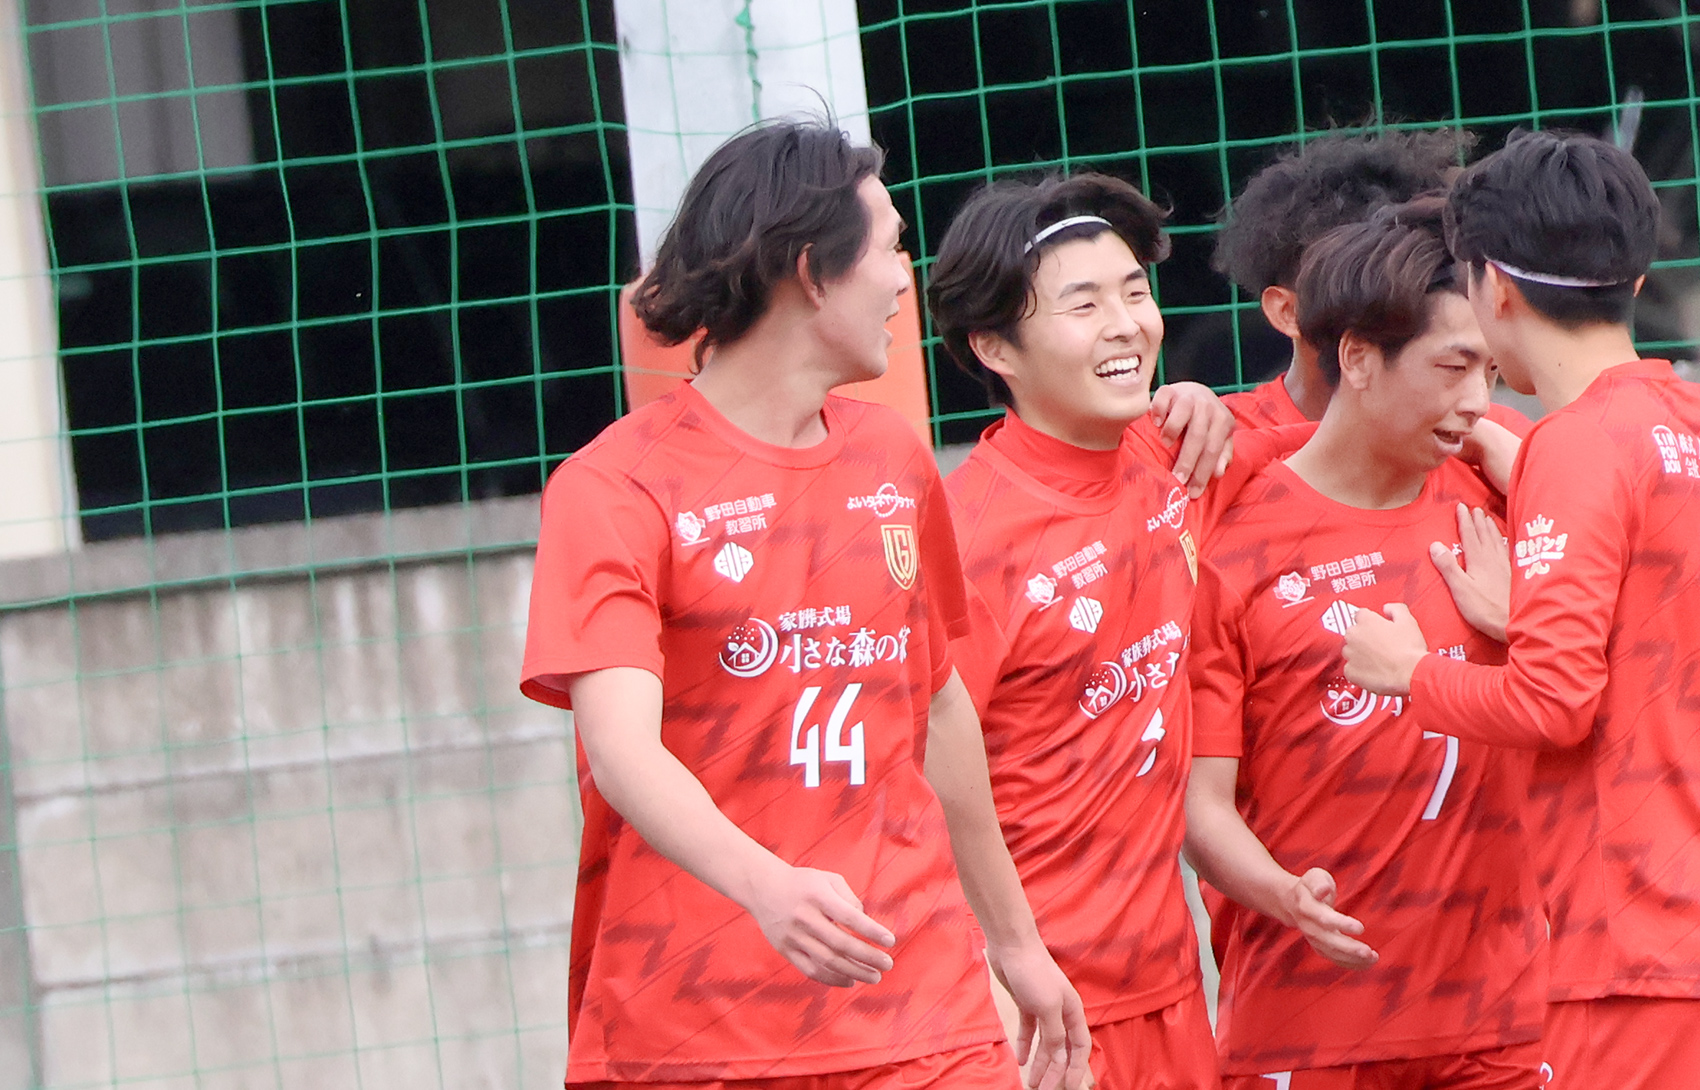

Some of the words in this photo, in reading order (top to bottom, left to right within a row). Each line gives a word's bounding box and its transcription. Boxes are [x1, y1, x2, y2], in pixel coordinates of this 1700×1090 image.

[1653, 432, 1676, 446] KIN
[1660, 446, 1678, 460] POU
[1664, 459, 1682, 473] DOU
[704, 493, 777, 522] 野田自動車
[725, 513, 768, 536] 教習所
[1052, 540, 1107, 579] 野田自動車
[1310, 551, 1385, 581] 野田自動車
[1071, 560, 1109, 590] 教習所
[1330, 570, 1377, 594] 教習所
[1120, 620, 1182, 668] 家族葬式場
[789, 683, 865, 787] 44
